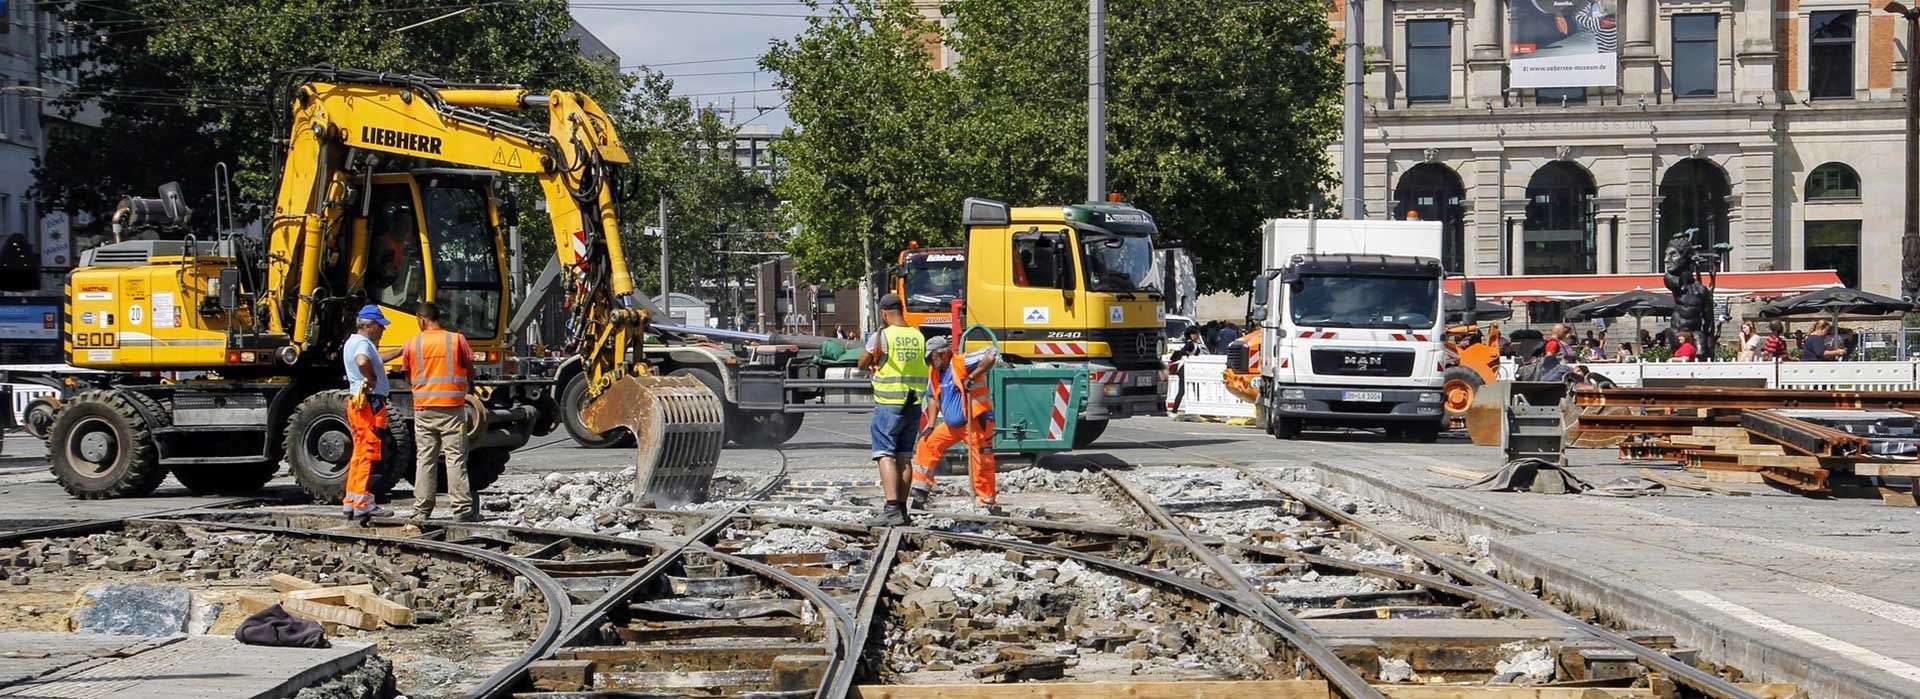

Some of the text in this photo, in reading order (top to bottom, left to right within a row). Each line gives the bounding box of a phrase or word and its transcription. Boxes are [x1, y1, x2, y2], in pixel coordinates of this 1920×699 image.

[361, 126, 442, 155] LIEBHERR
[131, 307, 141, 321] 20
[77, 333, 115, 346] 900
[895, 336, 919, 347] SIPO
[1344, 356, 1382, 365] MAN
